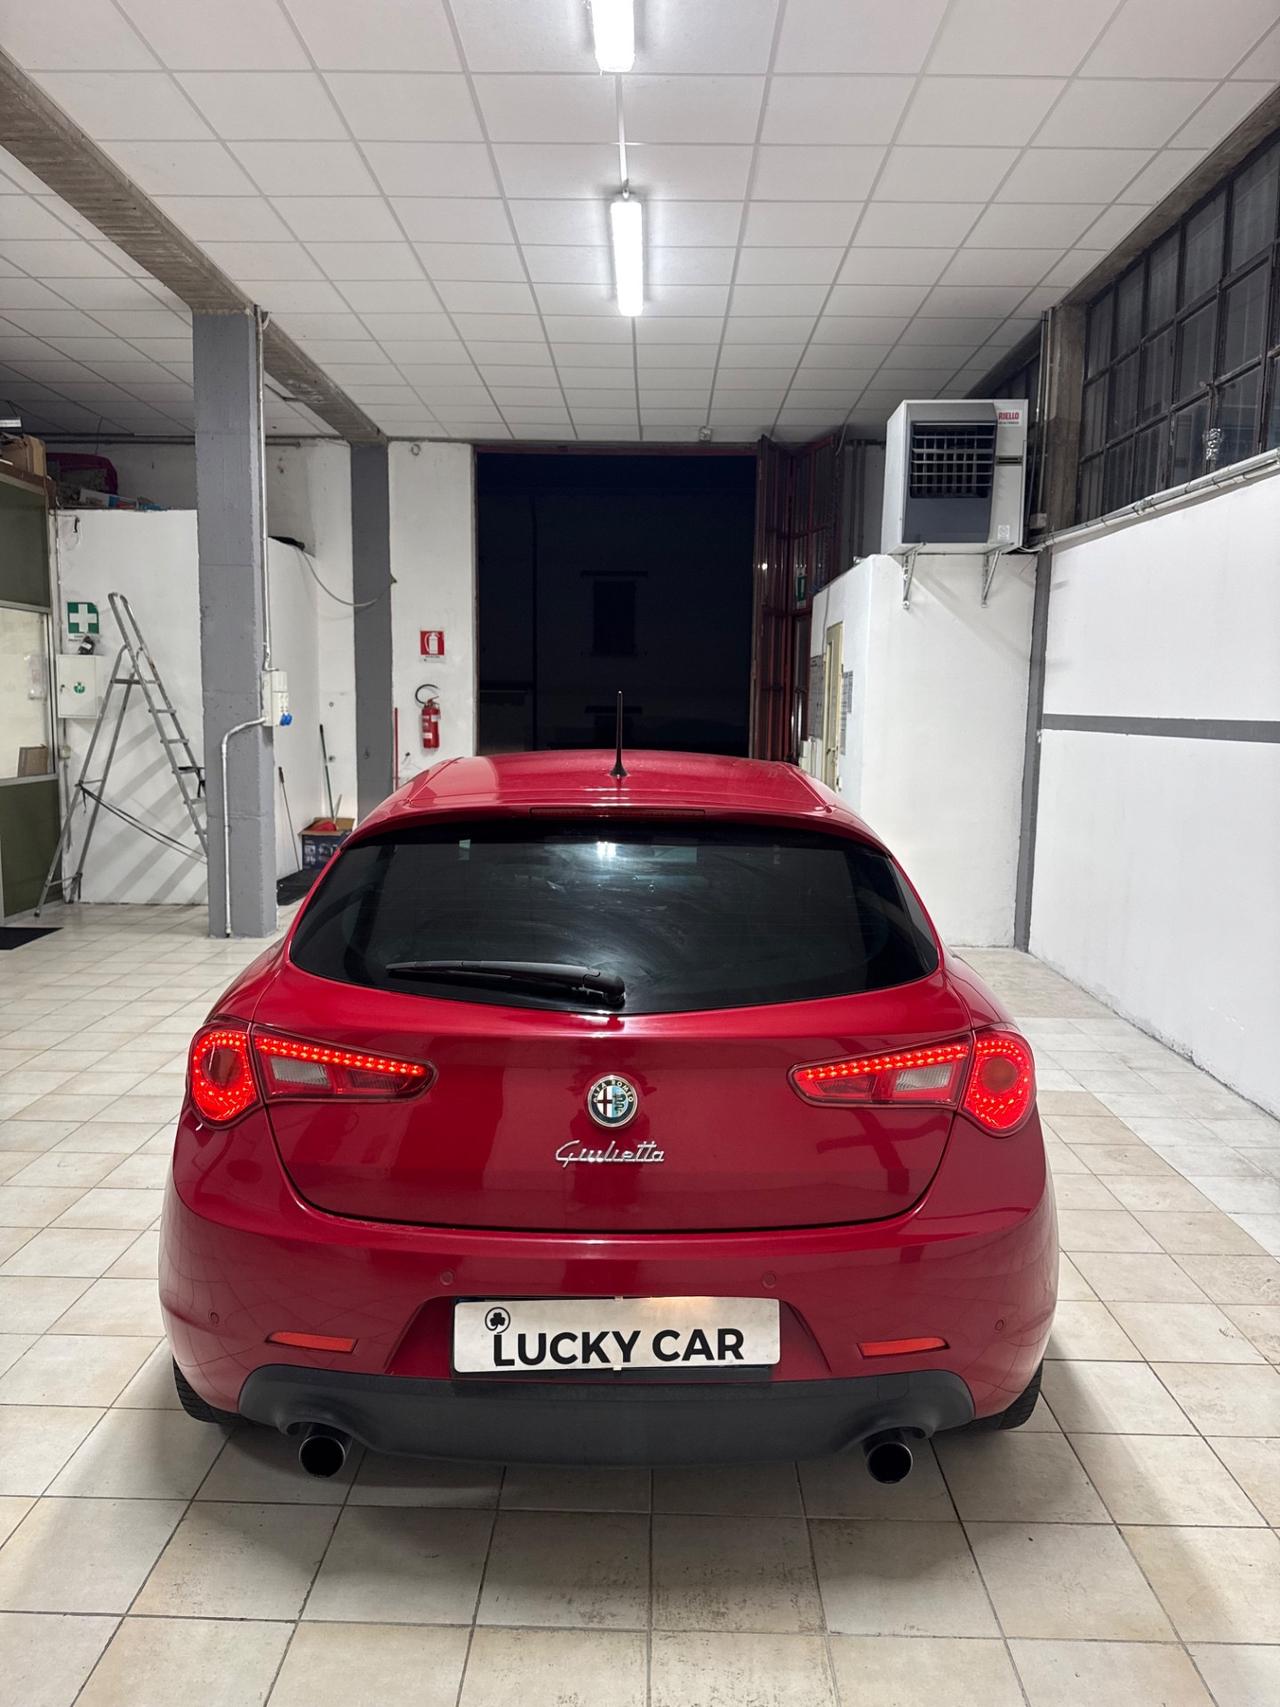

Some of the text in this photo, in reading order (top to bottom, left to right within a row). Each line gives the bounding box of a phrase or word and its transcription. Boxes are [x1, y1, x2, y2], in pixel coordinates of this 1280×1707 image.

[998, 411, 1020, 420] RIELLO
[611, 1080, 634, 1102] ROMEO
[555, 1139, 665, 1168] Giulietta
[493, 1328, 744, 1367] LUCKY CAR
